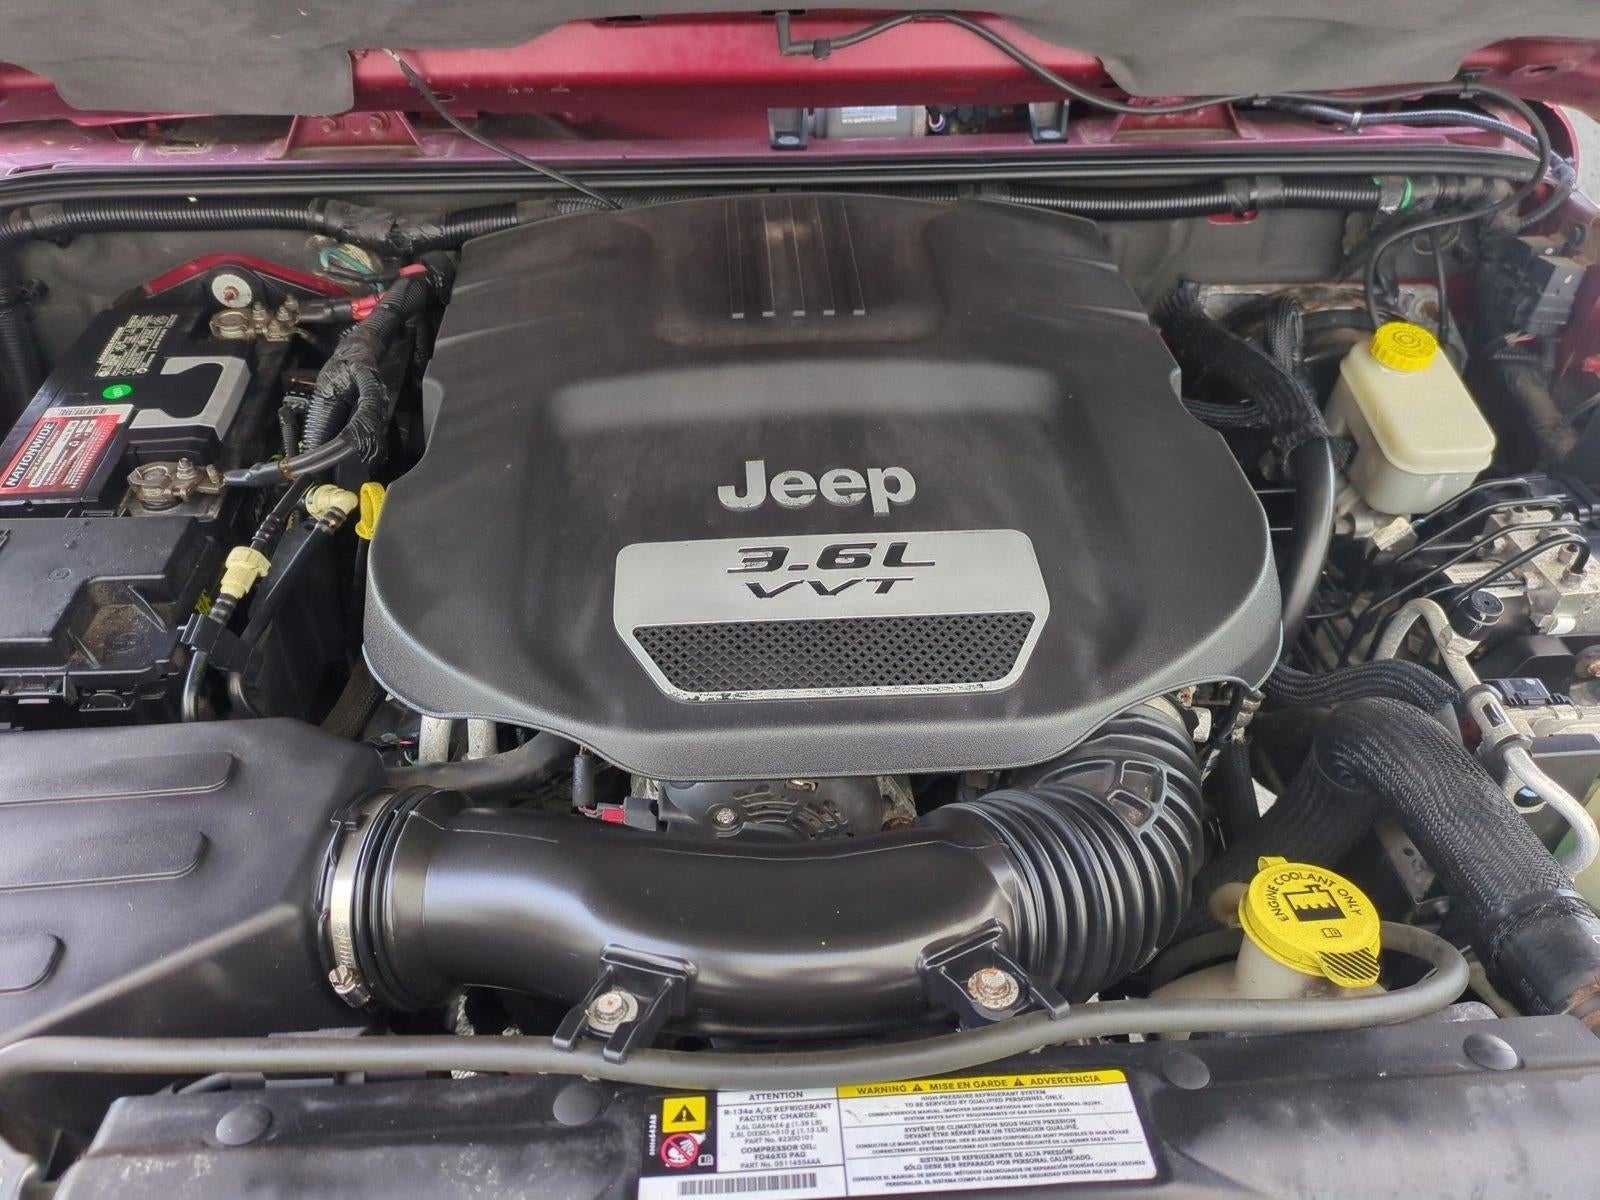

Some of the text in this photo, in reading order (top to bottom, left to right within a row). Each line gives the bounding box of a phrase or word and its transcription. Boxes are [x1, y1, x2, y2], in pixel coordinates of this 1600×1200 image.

[6, 422, 54, 486] NATIONWIDE
[717, 459, 916, 516] Jeep
[726, 541, 936, 574] 3.6L
[744, 577, 915, 600] VVT
[1266, 871, 1363, 922] ENGINE COOLANT ONLY
[856, 1074, 1101, 1095] WARNING MISE EN GARDE ADVERTENCIA
[749, 1091, 803, 1101] ATTENTION
[724, 1103, 832, 1115] R-134a A/C REFRIGERANT
[739, 1114, 778, 1122] FACTORY
[740, 1144, 798, 1153] COMPRESSOR
[962, 1152, 1012, 1160] REFRIGERANTE
[1043, 1147, 1073, 1156] PRESIÓN
[904, 1163, 922, 1171] SÓLO
[958, 1160, 995, 1168] REPARADO
[1012, 1157, 1049, 1165] PERSONAL
